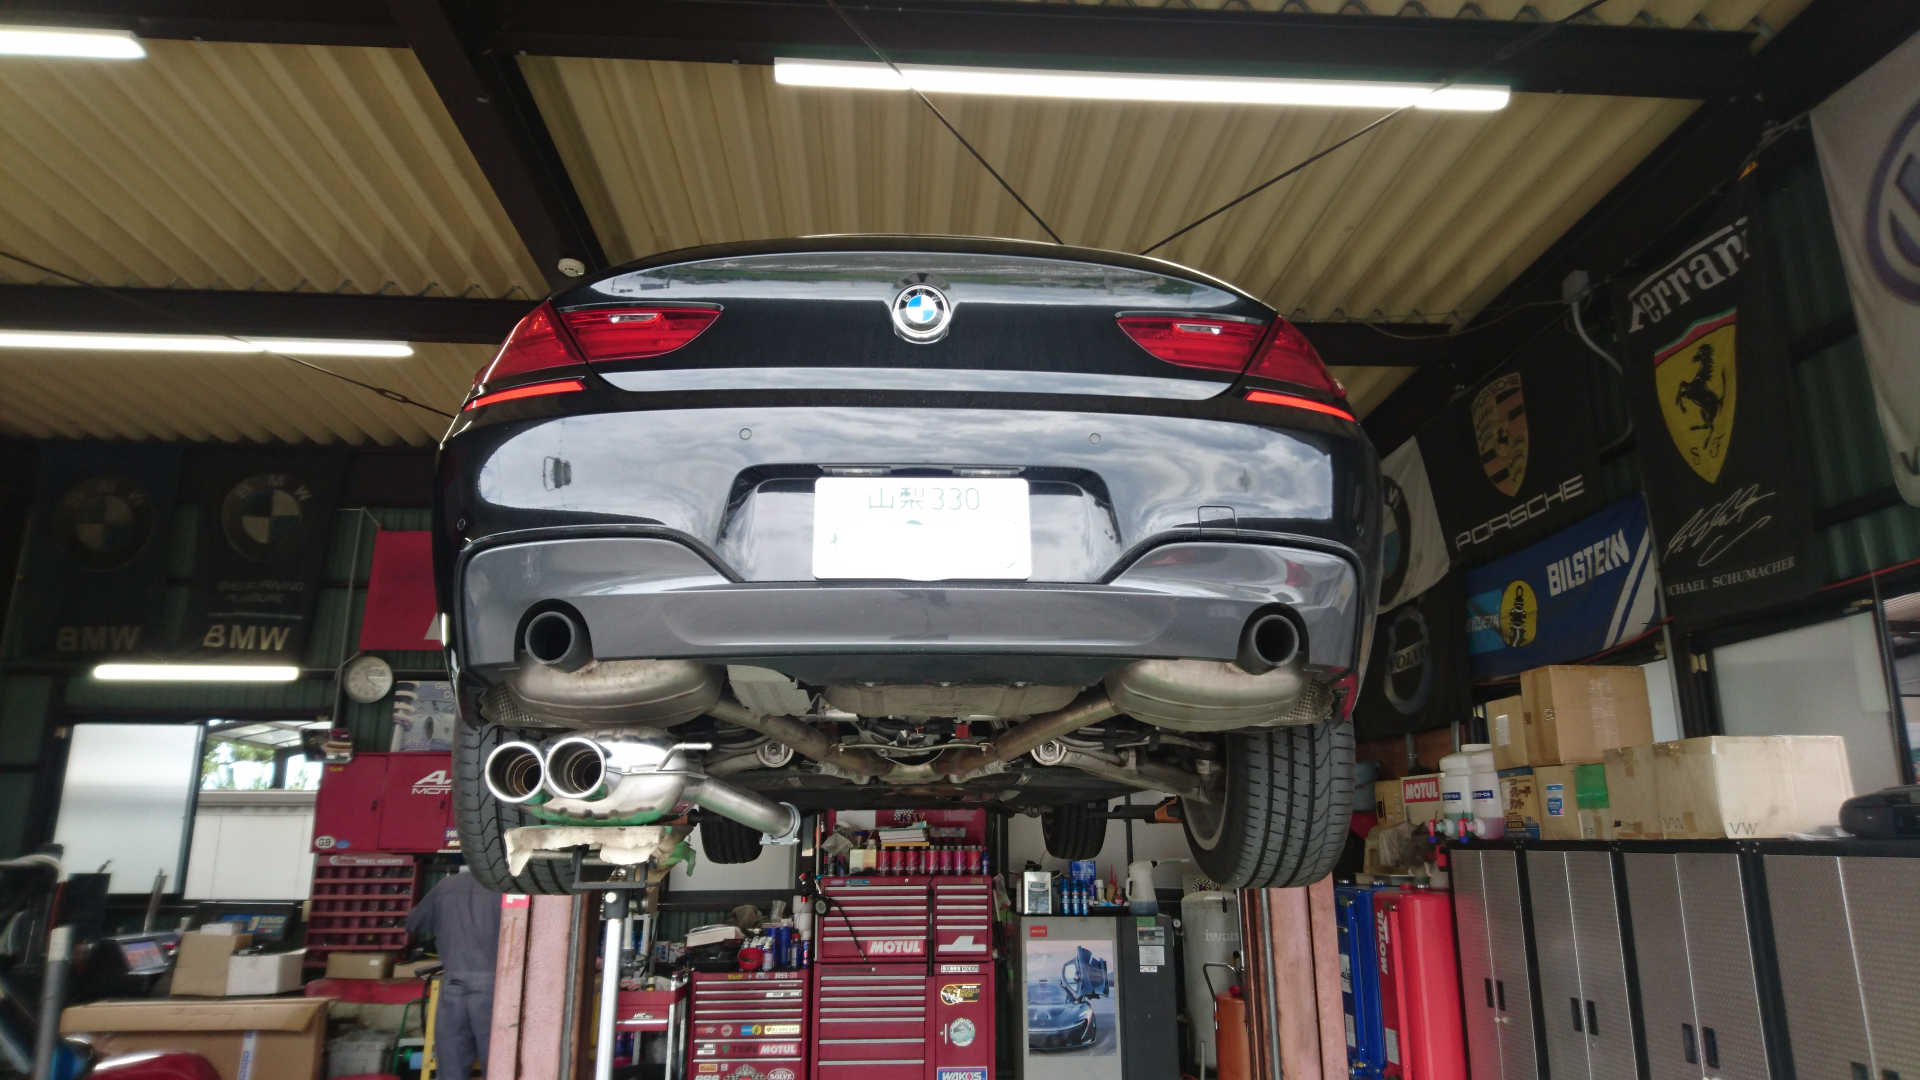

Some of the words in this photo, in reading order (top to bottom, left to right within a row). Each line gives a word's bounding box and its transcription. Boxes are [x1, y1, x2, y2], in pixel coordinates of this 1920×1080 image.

[1627, 216, 1752, 334] Ferrari
[902, 288, 941, 303] BMW
[1473, 375, 1519, 411] PORSCHE
[1455, 474, 1585, 551] PORSCHE
[1546, 528, 1630, 597] BILSTEIN
[1712, 556, 1796, 588] SCHUMACHER
[56, 625, 141, 652] BMW
[202, 624, 290, 651] BMW
[1388, 643, 1430, 673] VOLVO
[1405, 781, 1439, 802] MOTUL
[1663, 817, 1683, 830] VW
[1729, 822, 1757, 836] VW
[318, 838, 331, 847] GB
[869, 941, 920, 954] MOTUL
[1377, 909, 1388, 975] MOTUL
[760, 1044, 796, 1054] MOTUL
